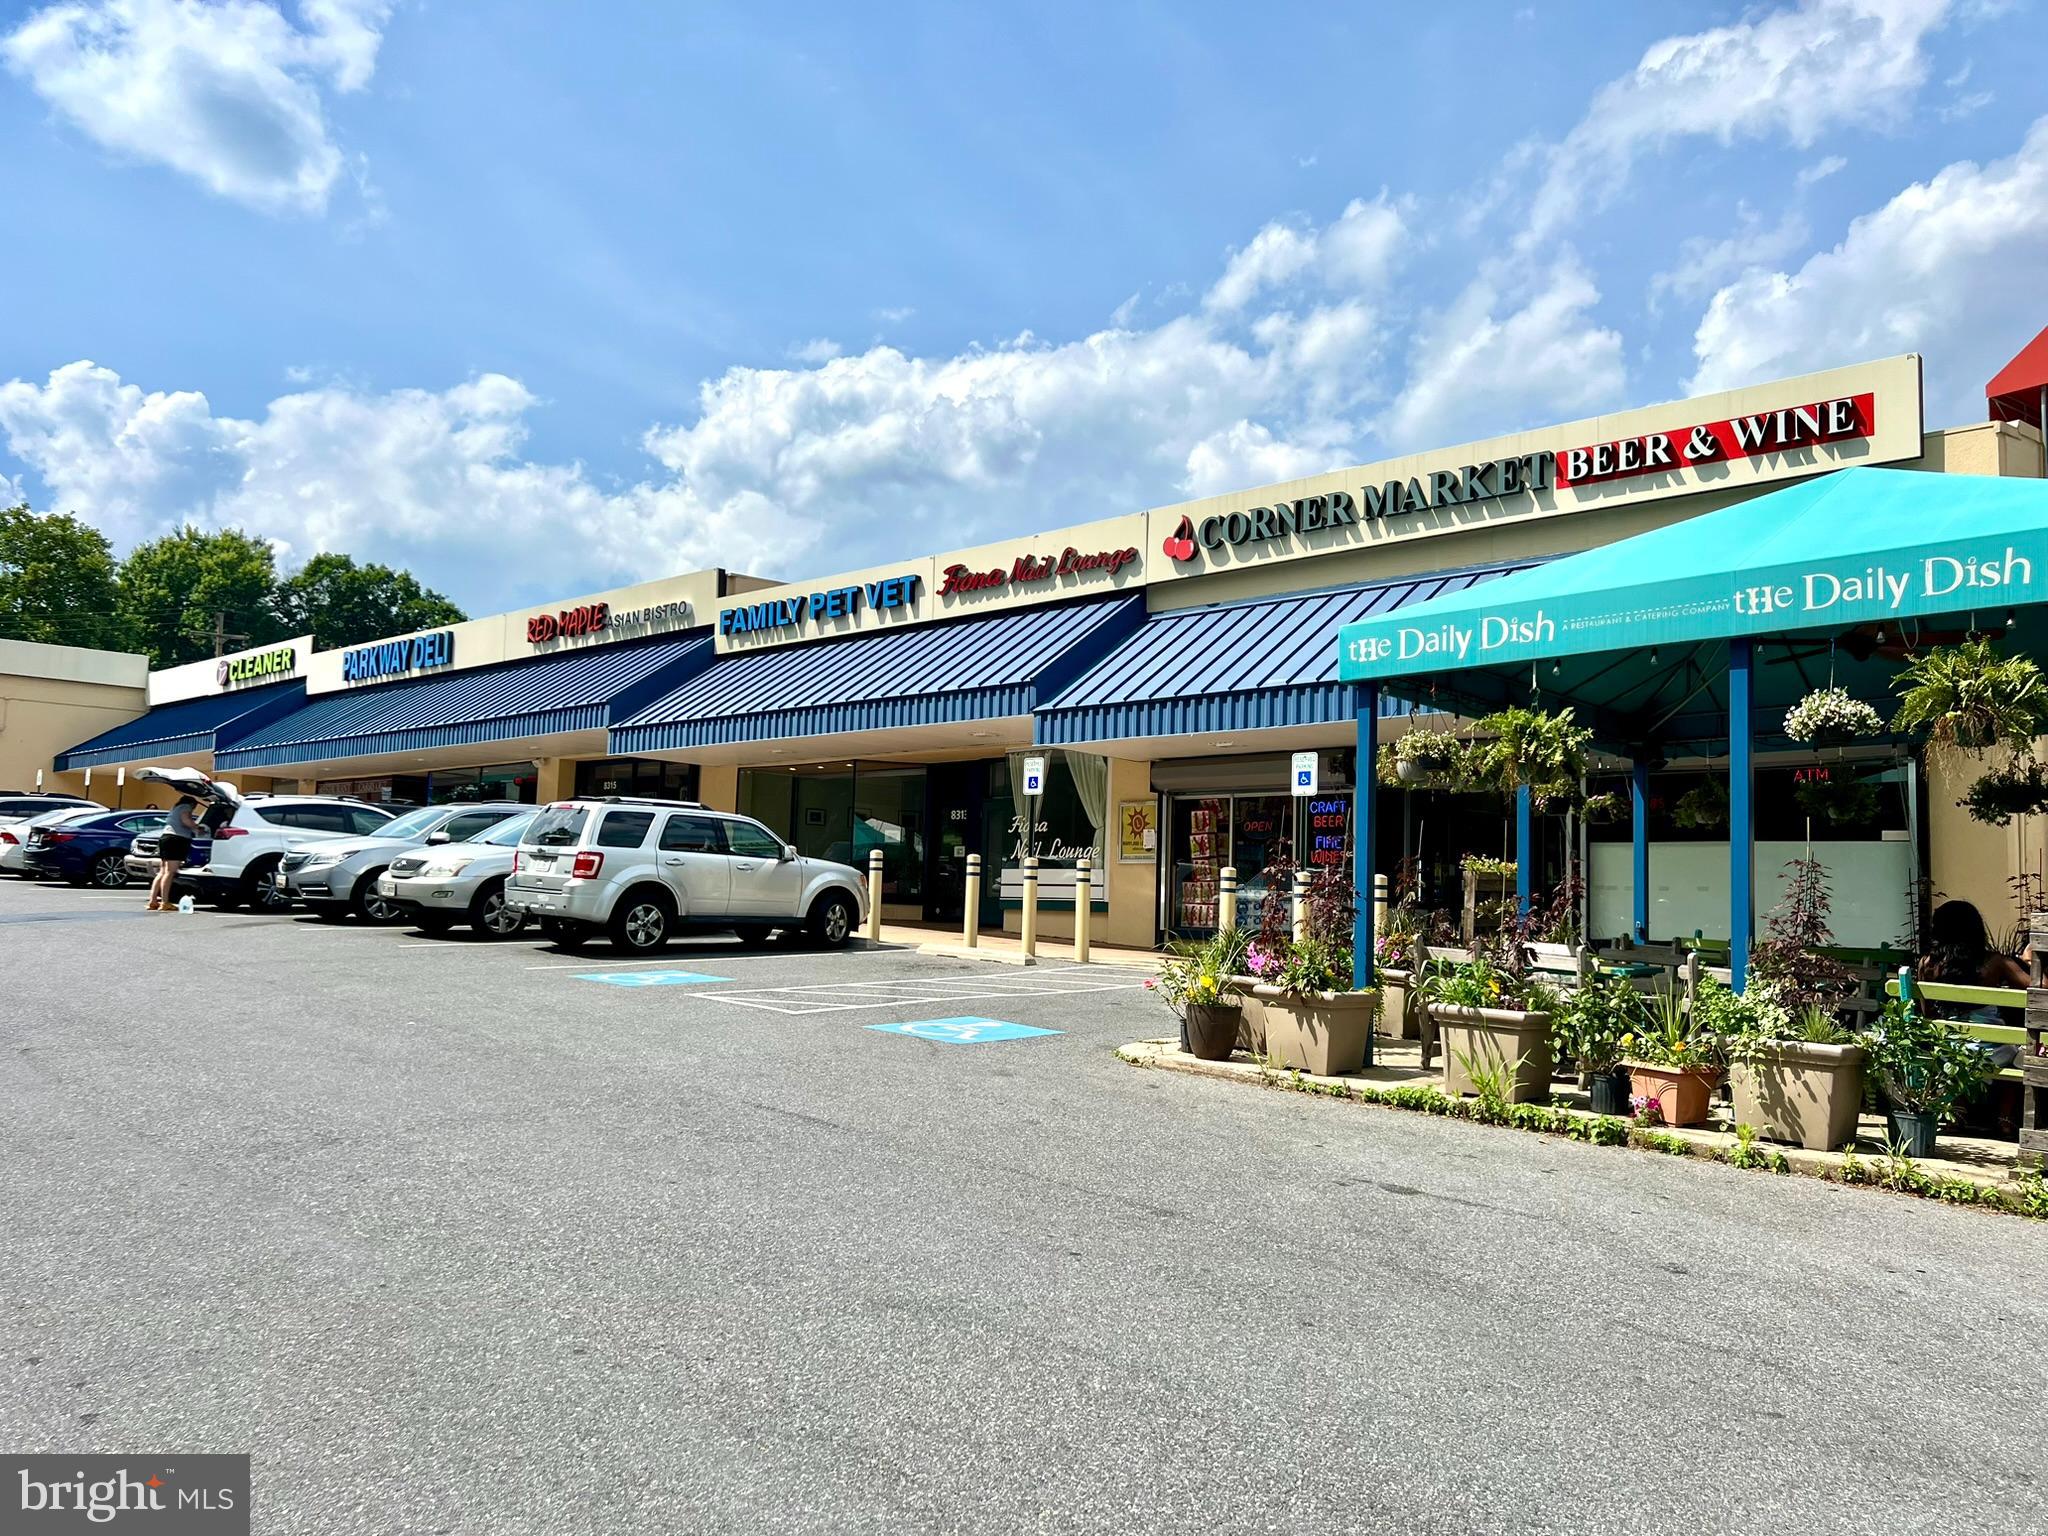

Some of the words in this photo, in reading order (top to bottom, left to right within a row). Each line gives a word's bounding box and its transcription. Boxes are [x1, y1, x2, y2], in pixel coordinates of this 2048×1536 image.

[1567, 434, 1671, 481] BEER
[1683, 425, 1716, 459] &
[1729, 398, 1854, 448] WINE
[1198, 491, 1357, 549] CORNER
[1361, 451, 1554, 521] MARKET
[936, 564, 1006, 596] Fiona
[1007, 554, 1056, 583] Nail
[1055, 547, 1138, 576] Lounge
[1802, 567, 1910, 610] Daily
[1920, 547, 2031, 597] Dish
[607, 611, 639, 629] ASIAN
[644, 601, 687, 622] BISTRO
[720, 596, 806, 635] FAMILY
[810, 586, 863, 620] PET
[865, 575, 921, 609] VET
[1562, 623, 1568, 631] A
[1571, 617, 1622, 629] RESTAURANT
[1625, 615, 1632, 623] &
[1635, 609, 1679, 622] CATERING
[1682, 603, 1730, 615] COMPANY
[527, 615, 556, 642] RED
[558, 603, 608, 637] MAPLE
[1397, 625, 1472, 660] Daily
[1479, 610, 1554, 650] Dish
[229, 648, 294, 681] CLEANER
[343, 640, 411, 682] PARKWAY
[413, 631, 452, 668] DELI
[603, 781, 617, 790] 8315
[1794, 768, 1829, 782] ATM
[1309, 801, 1346, 814] CRAFT
[1313, 815, 1344, 828] BEER
[1243, 821, 1273, 832] OPEN
[1049, 838, 1101, 861] Lounge
